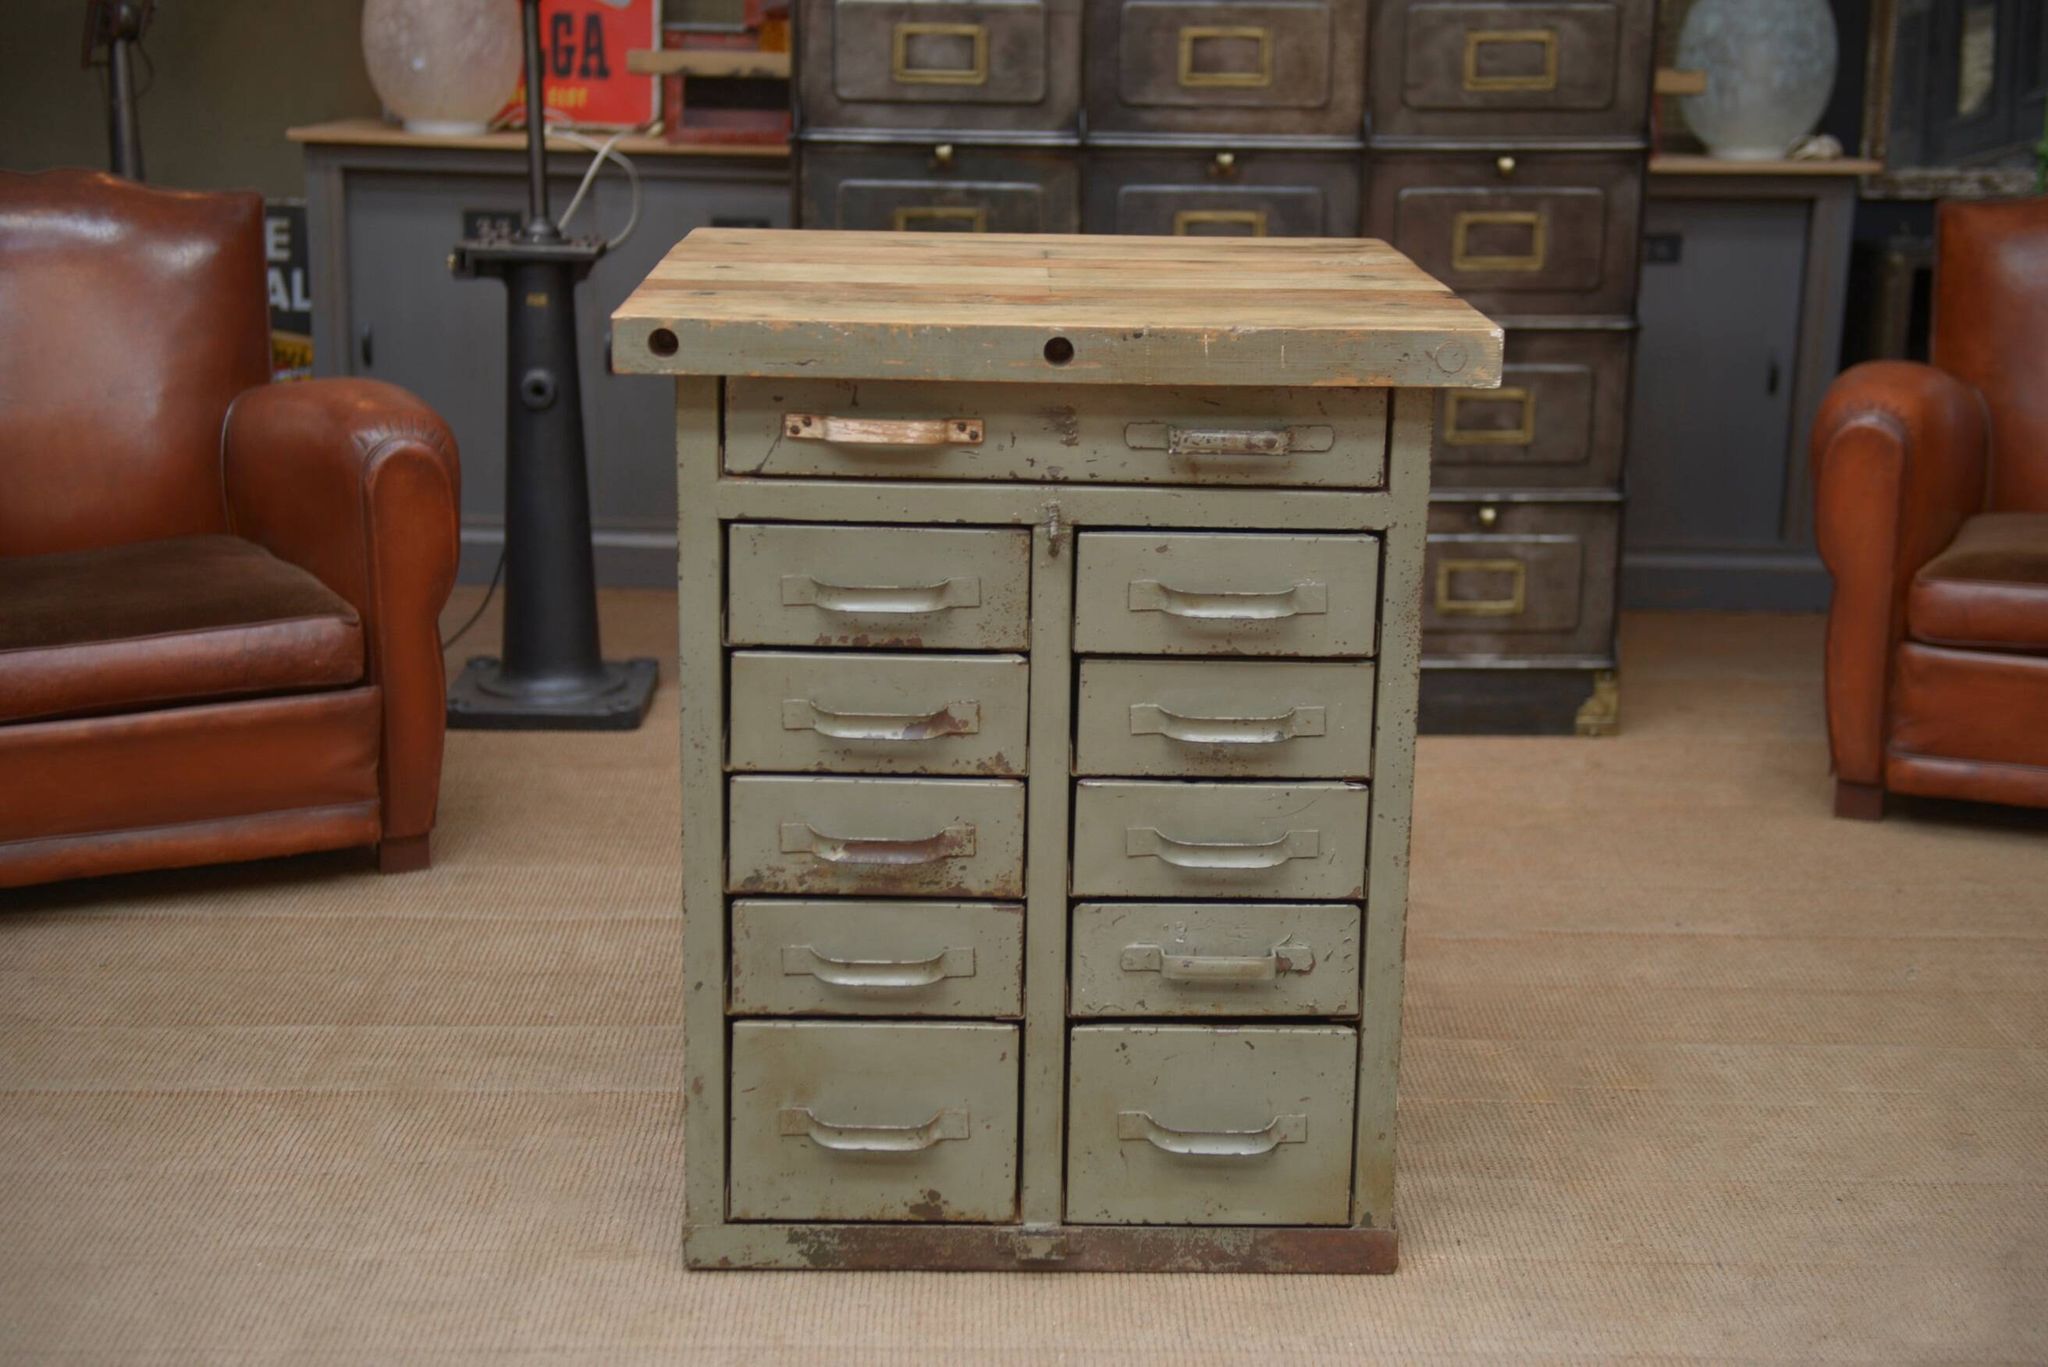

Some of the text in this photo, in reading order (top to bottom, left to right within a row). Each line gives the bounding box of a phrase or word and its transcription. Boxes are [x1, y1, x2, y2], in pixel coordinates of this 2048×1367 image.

[542, 12, 611, 80] GA
[265, 216, 291, 262] E
[267, 267, 312, 312] AL
